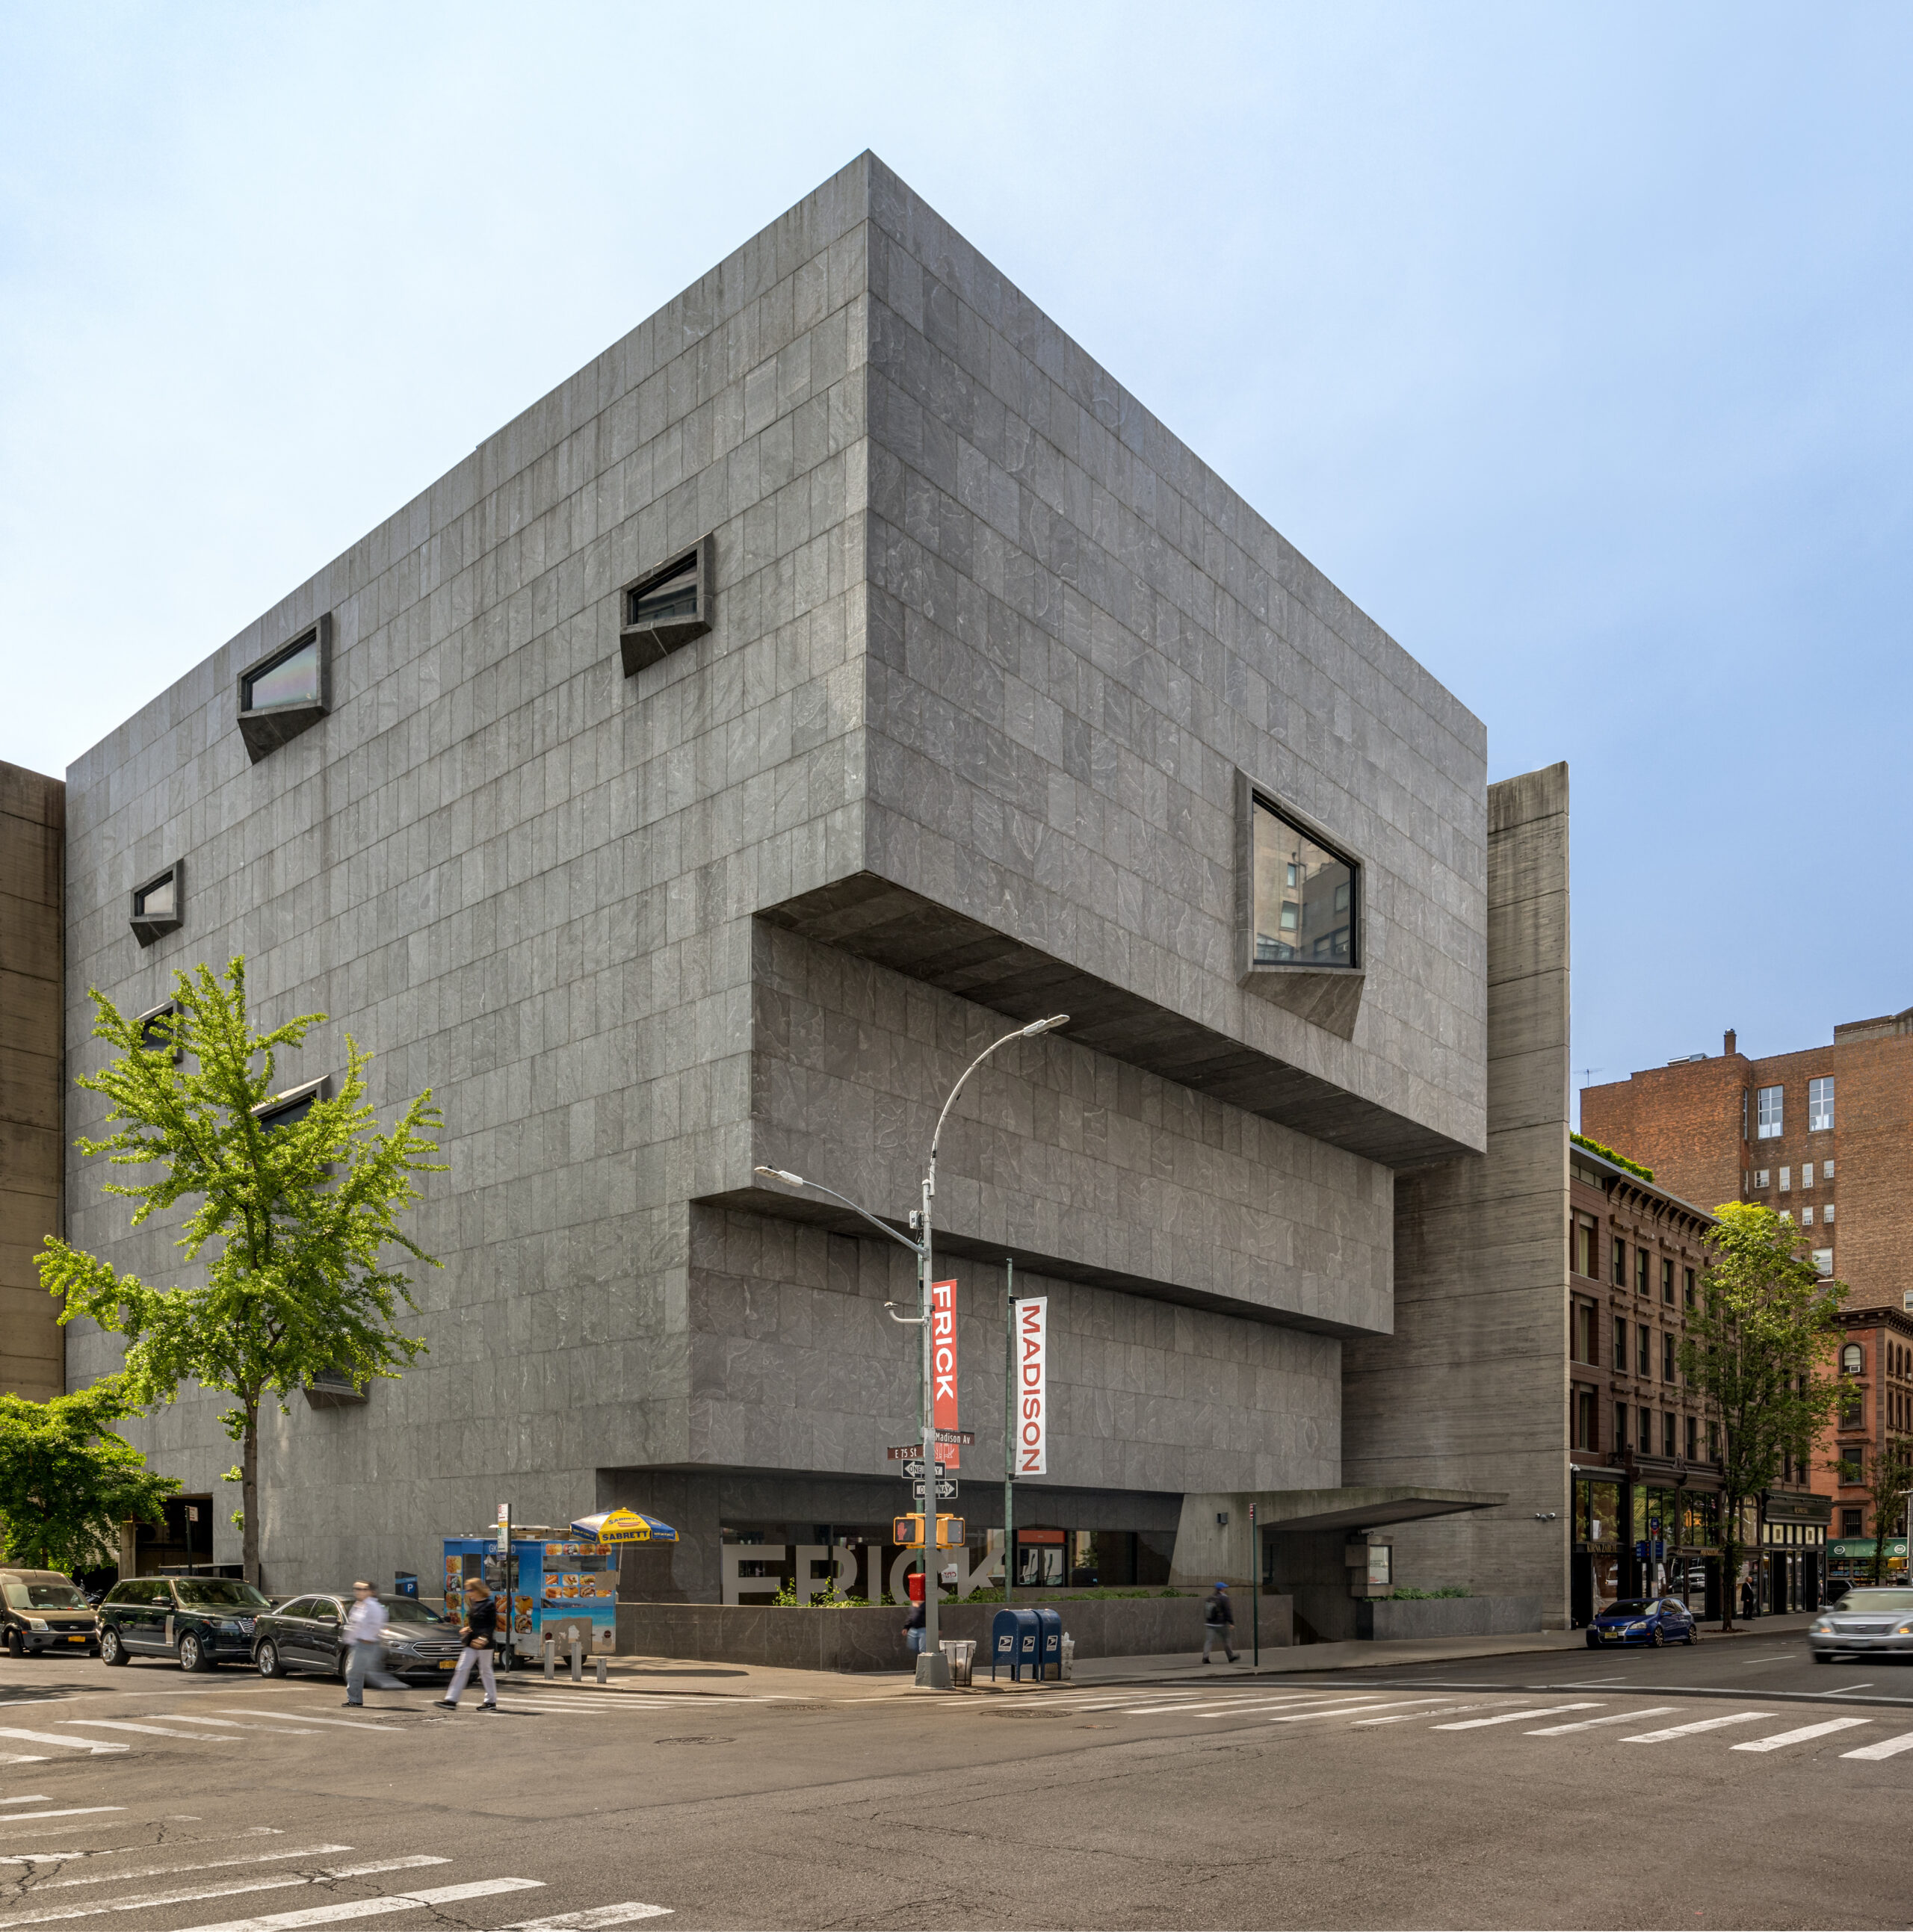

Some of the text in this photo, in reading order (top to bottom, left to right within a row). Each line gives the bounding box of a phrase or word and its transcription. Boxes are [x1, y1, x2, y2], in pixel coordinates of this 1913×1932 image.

[933, 1285, 954, 1401] FRICK
[1022, 1305, 1040, 1471] MADISON
[935, 1432, 971, 1444] Madison Av
[894, 1448, 917, 1458] E 75 St
[602, 1531, 648, 1541] SABRETT
[723, 1544, 1006, 1606] FRICK
[407, 1583, 413, 1592] P
